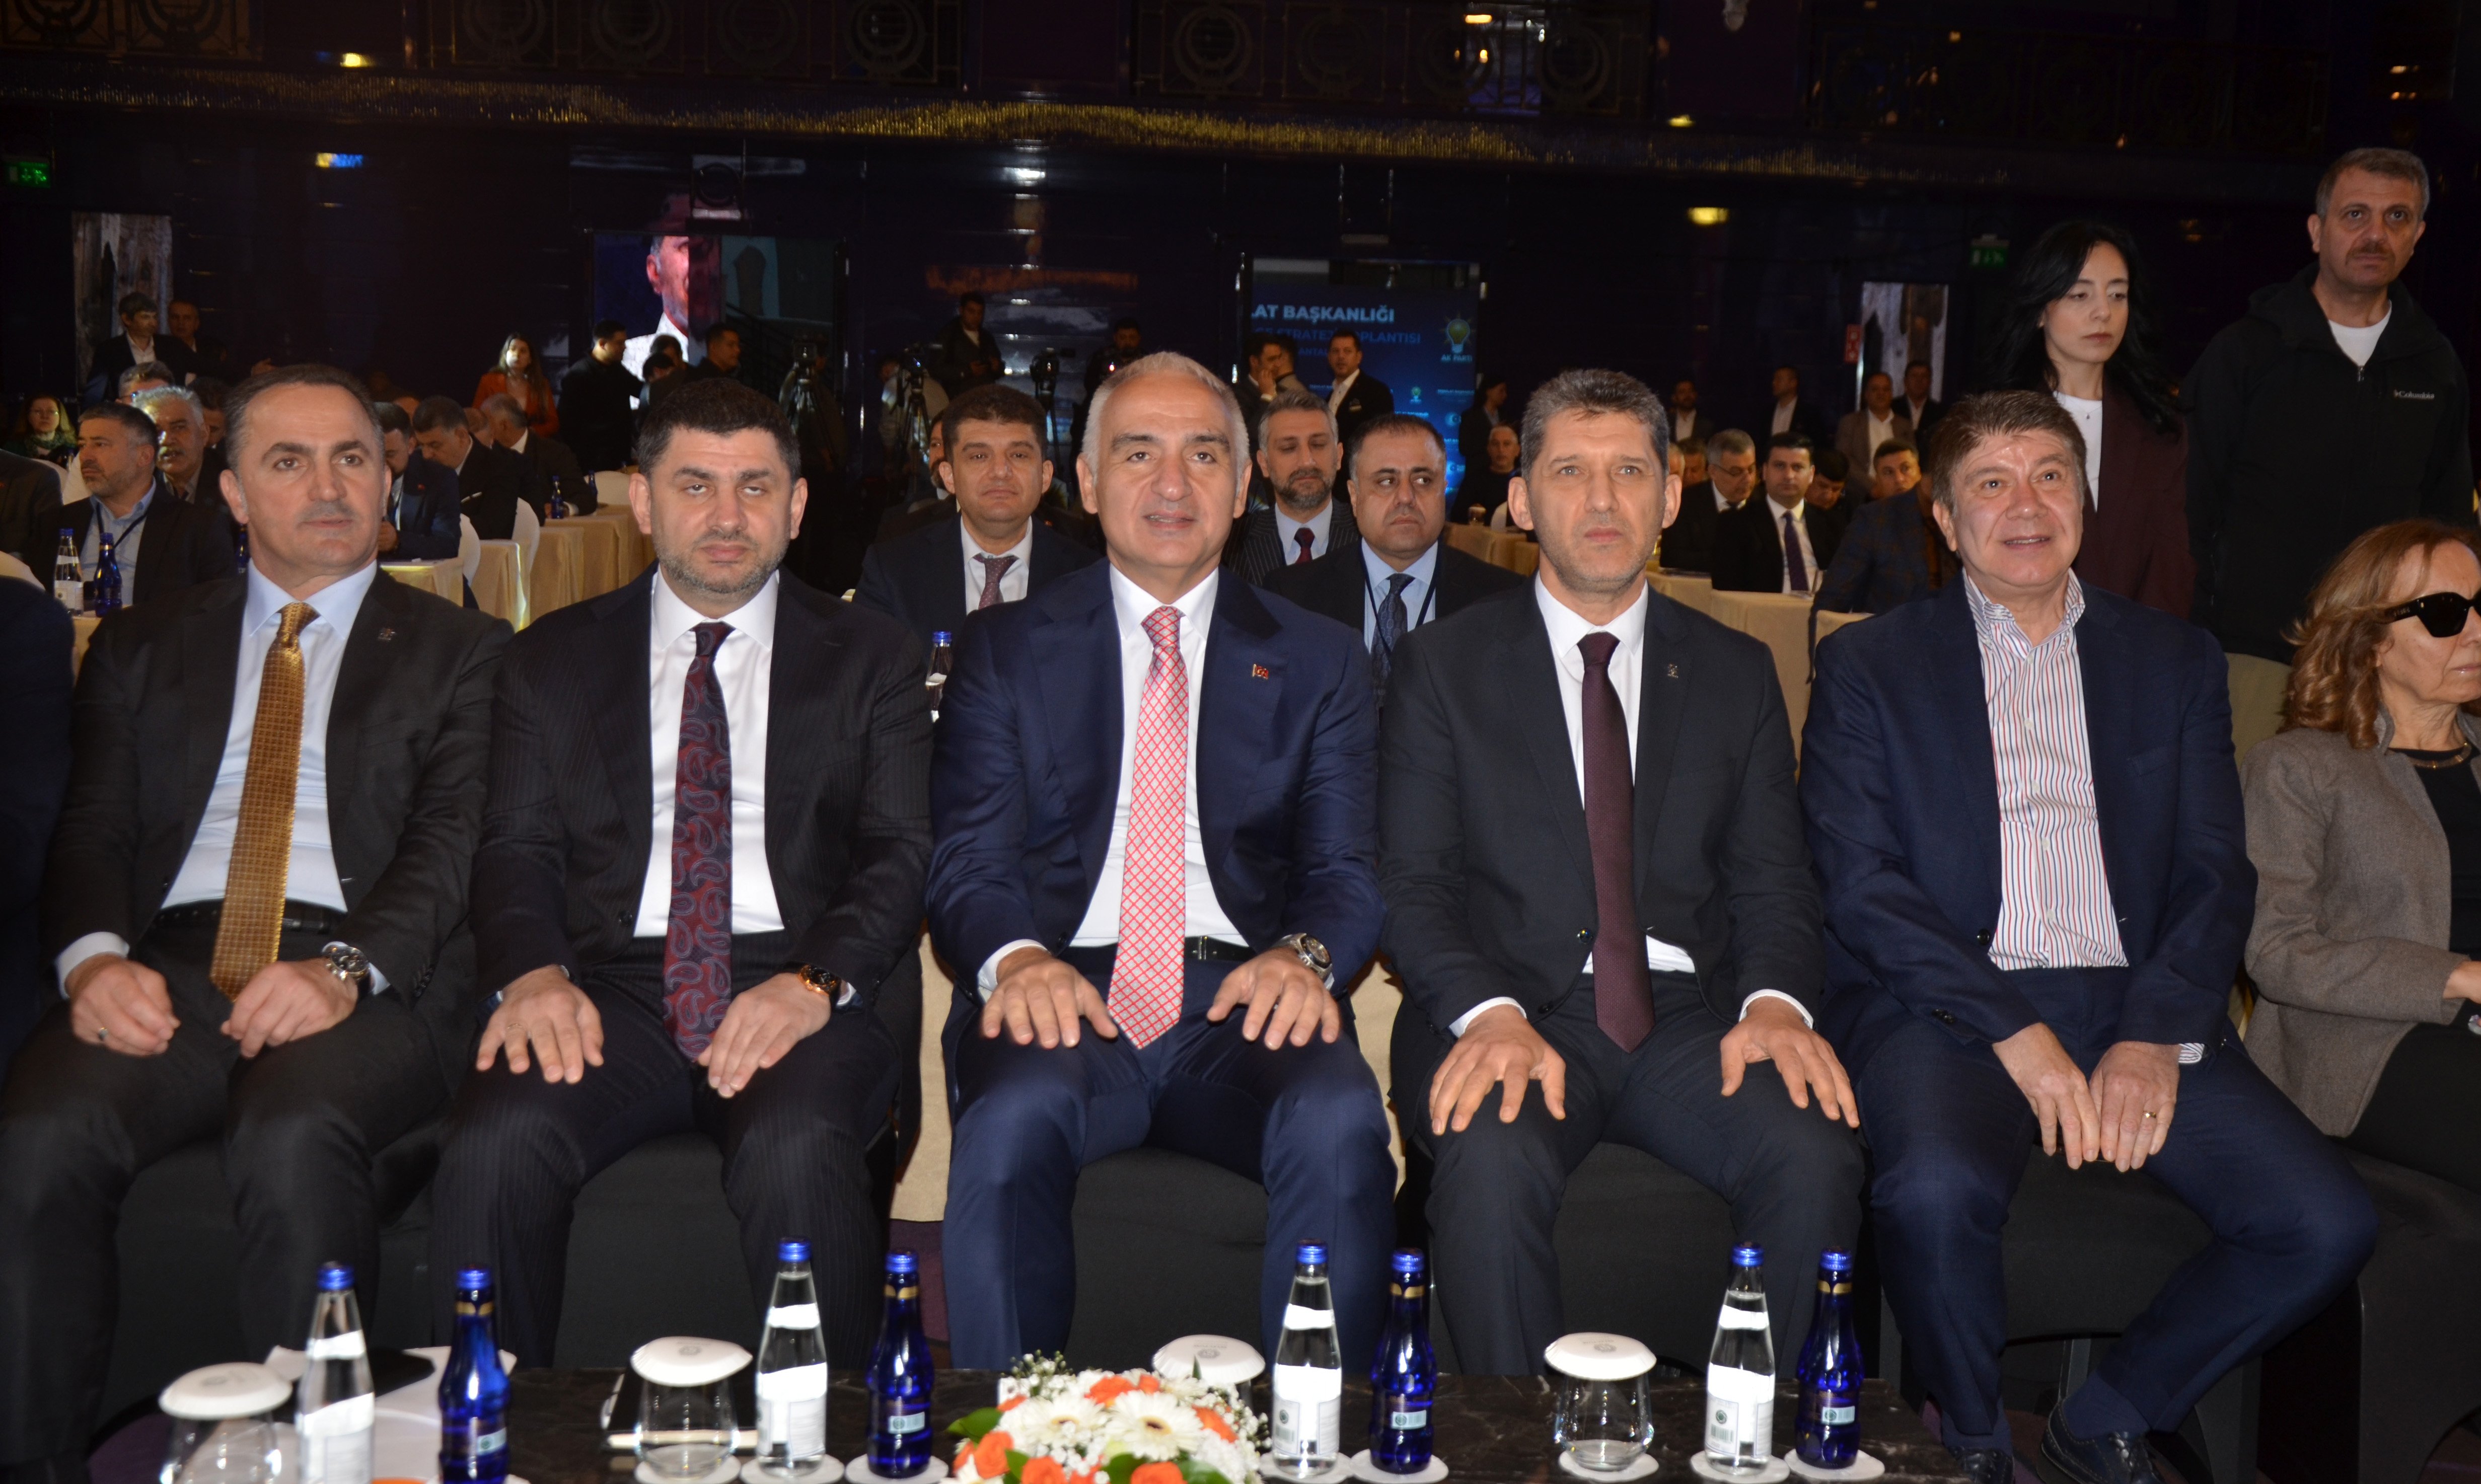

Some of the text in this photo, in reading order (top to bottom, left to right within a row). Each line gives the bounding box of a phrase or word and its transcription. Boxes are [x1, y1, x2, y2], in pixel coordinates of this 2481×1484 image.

[1251, 304, 1395, 325] AT BAŞKANLIĞI
[1276, 327, 1338, 340] STRATEJ
[1356, 331, 1421, 343] PLANTISI
[2398, 391, 2435, 400] Columbia
